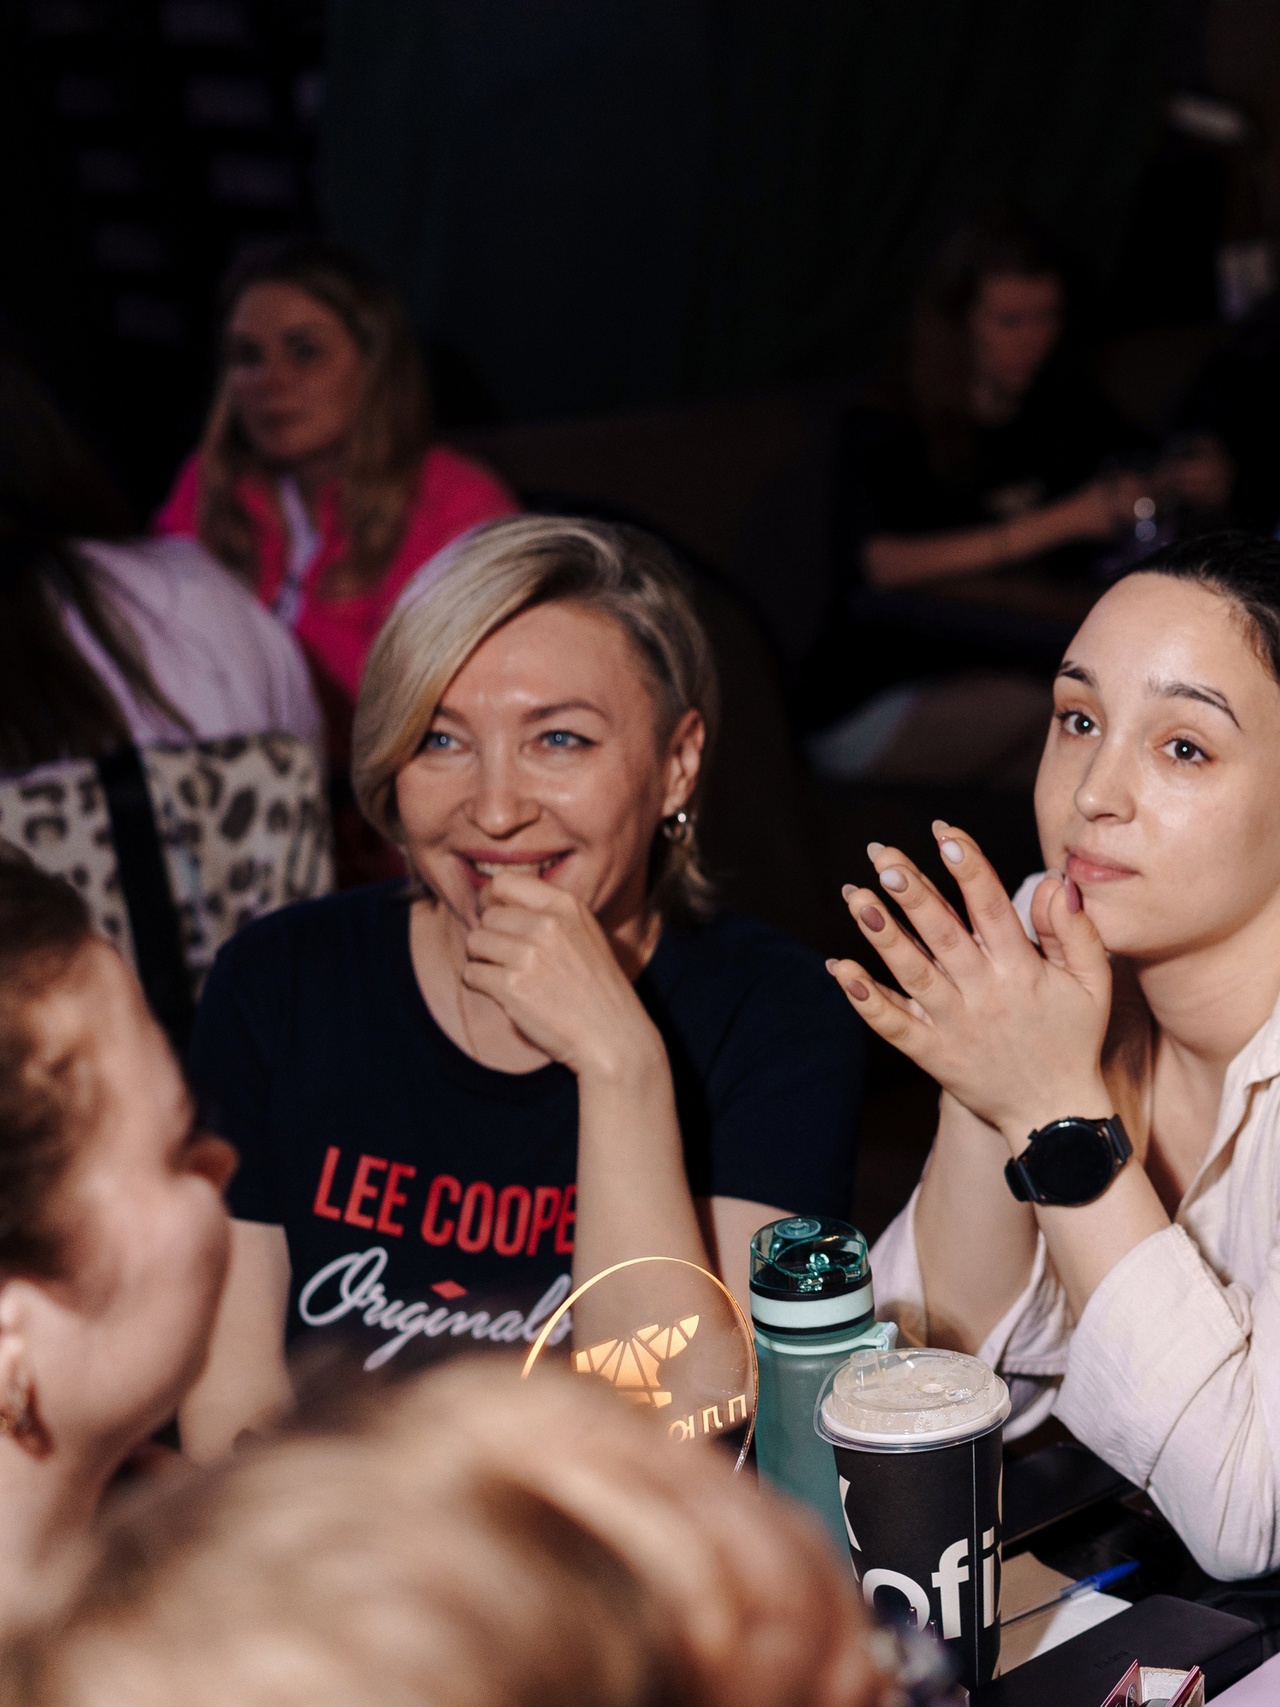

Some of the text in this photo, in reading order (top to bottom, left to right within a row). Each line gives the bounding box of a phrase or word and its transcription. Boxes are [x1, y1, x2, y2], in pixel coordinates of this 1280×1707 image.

[313, 1146, 577, 1257] LEE COOPE
[298, 1246, 573, 1371] Originals
[852, 1525, 1001, 1640] ofi
